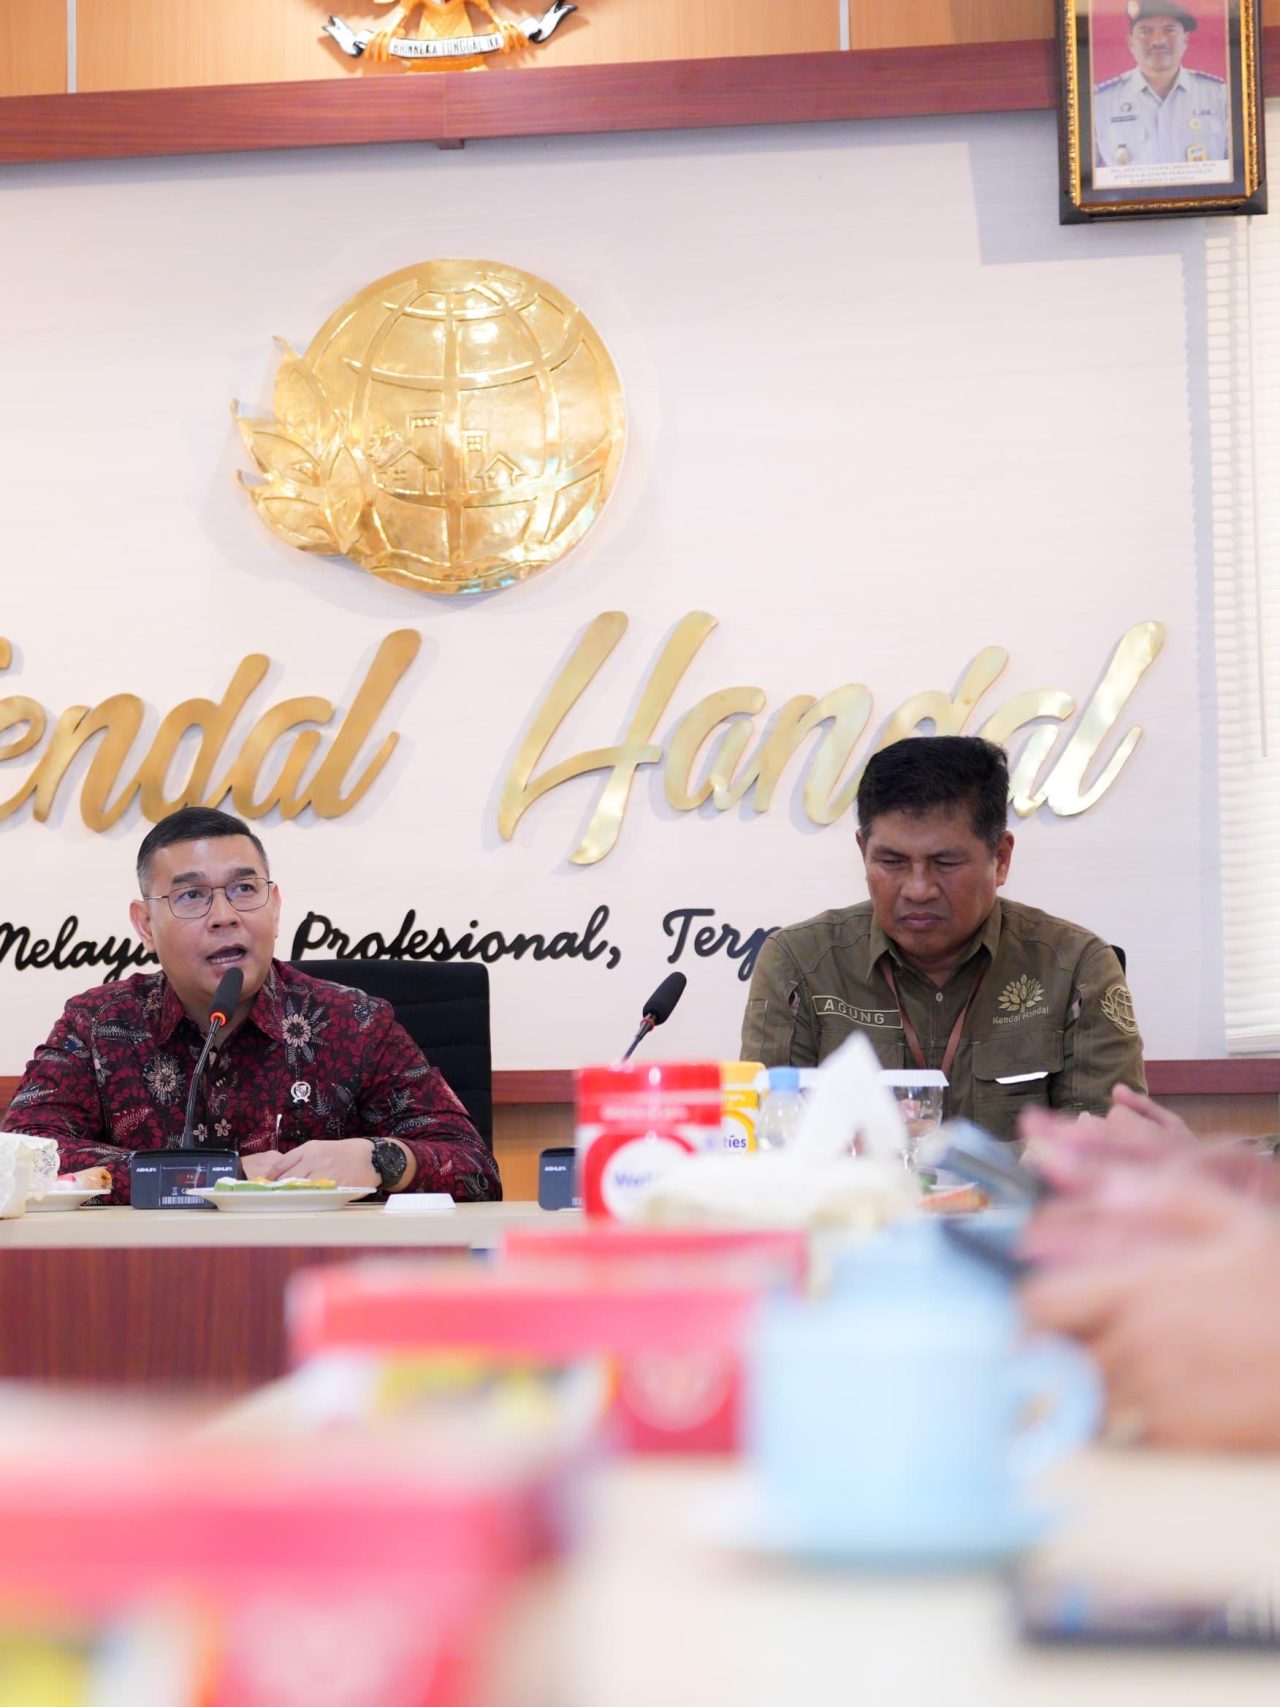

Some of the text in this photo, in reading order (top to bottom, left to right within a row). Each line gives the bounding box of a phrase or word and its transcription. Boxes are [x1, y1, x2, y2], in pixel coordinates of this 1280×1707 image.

[290, 904, 622, 970] Profesional,
[823, 999, 885, 1025] AGUNG
[992, 1005, 1049, 1025] Kendal Handal
